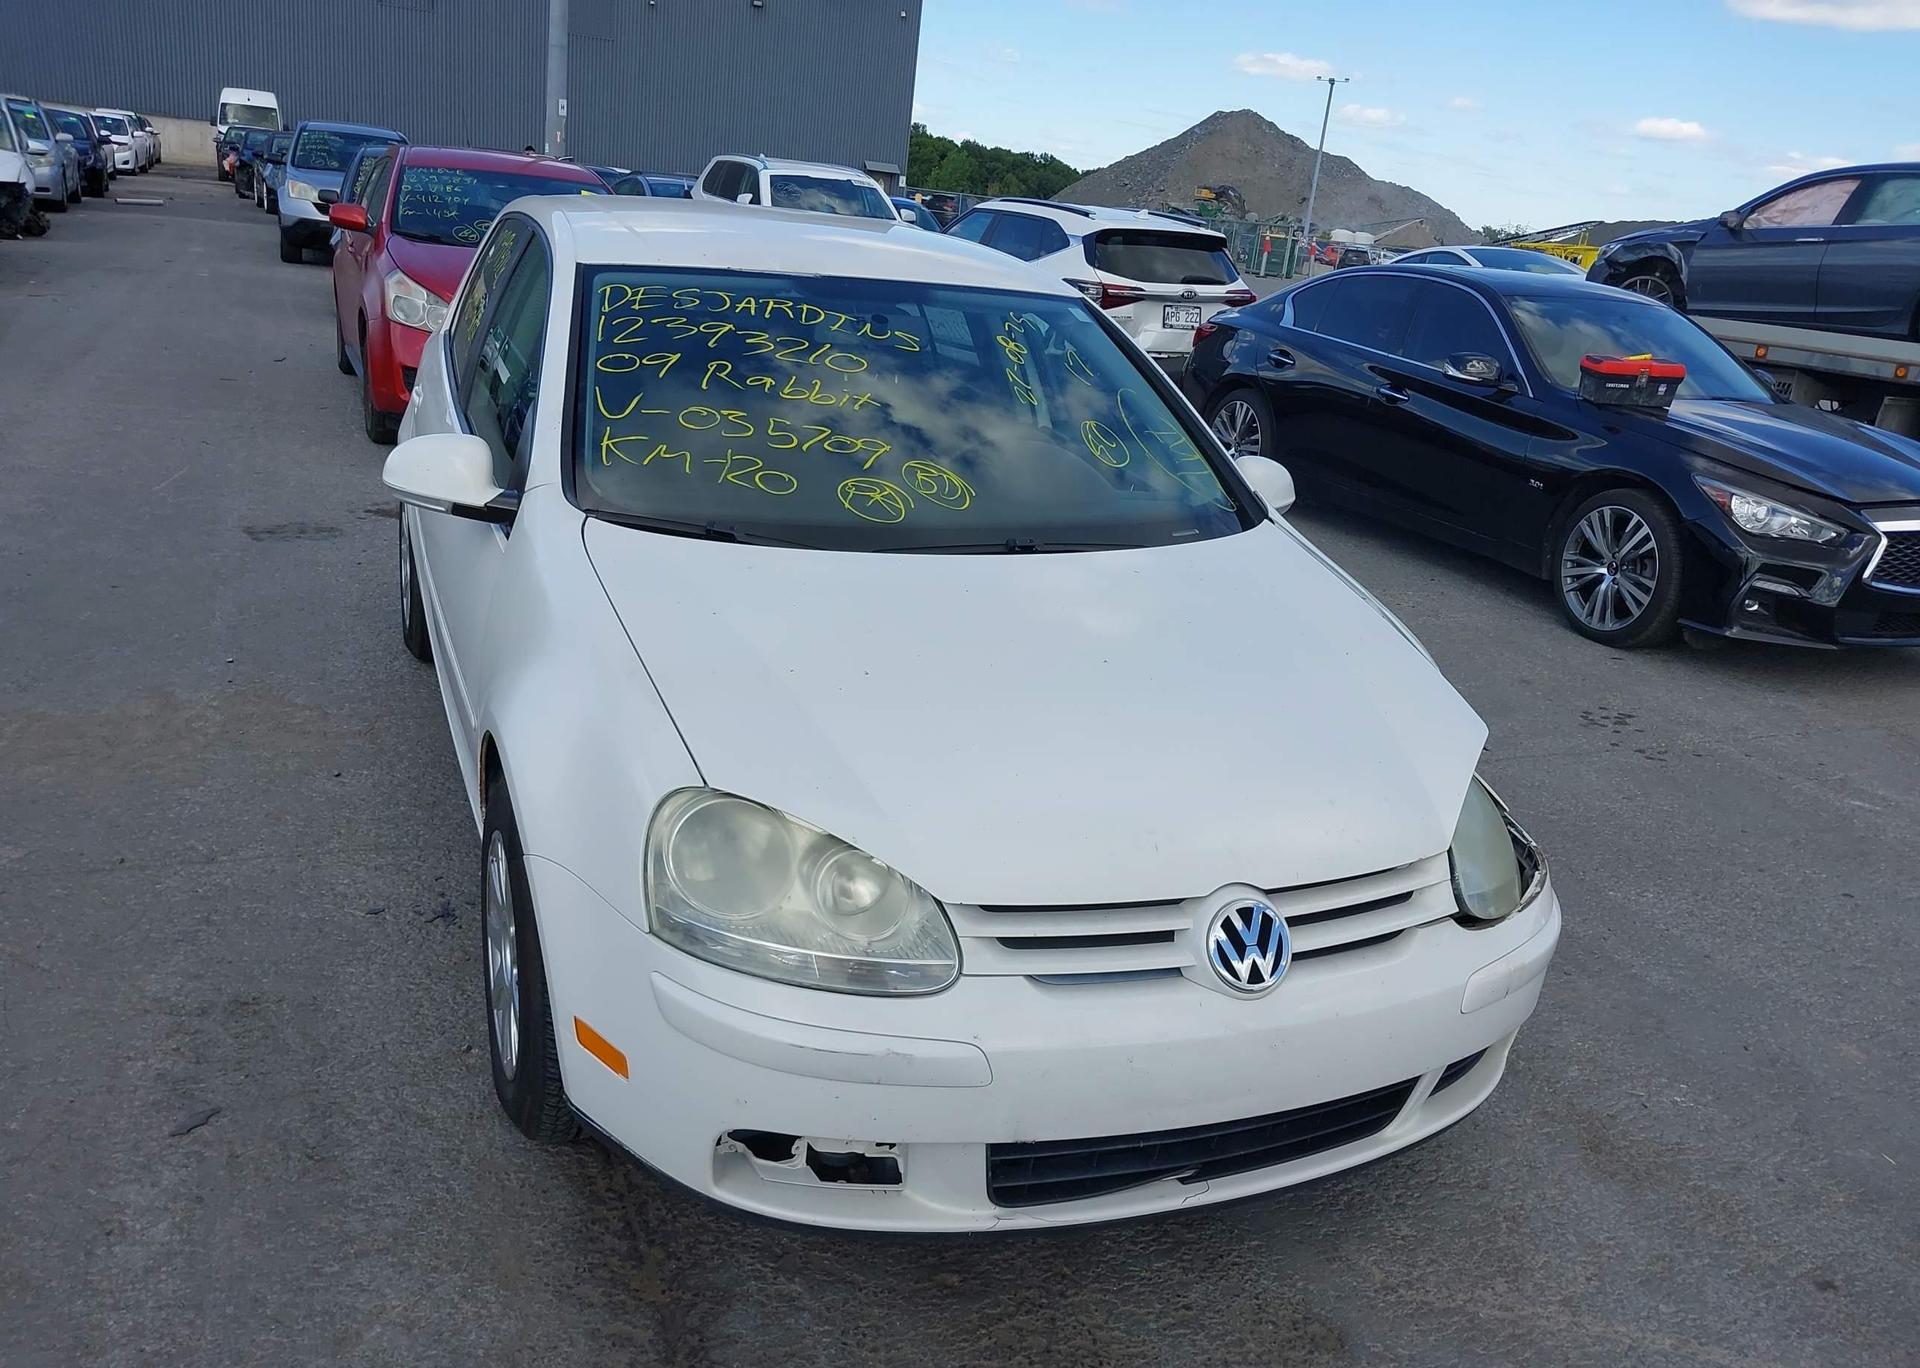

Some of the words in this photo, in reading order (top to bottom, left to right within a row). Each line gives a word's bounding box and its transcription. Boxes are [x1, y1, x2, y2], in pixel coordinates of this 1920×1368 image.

[598, 284, 921, 351] DESJARDINS
[1165, 311, 1180, 323] APG
[1182, 290, 1196, 299] KIA
[597, 315, 868, 373] 12393210
[597, 352, 682, 379] 09
[701, 360, 882, 411] Rabbit
[1207, 899, 1291, 993] VW
